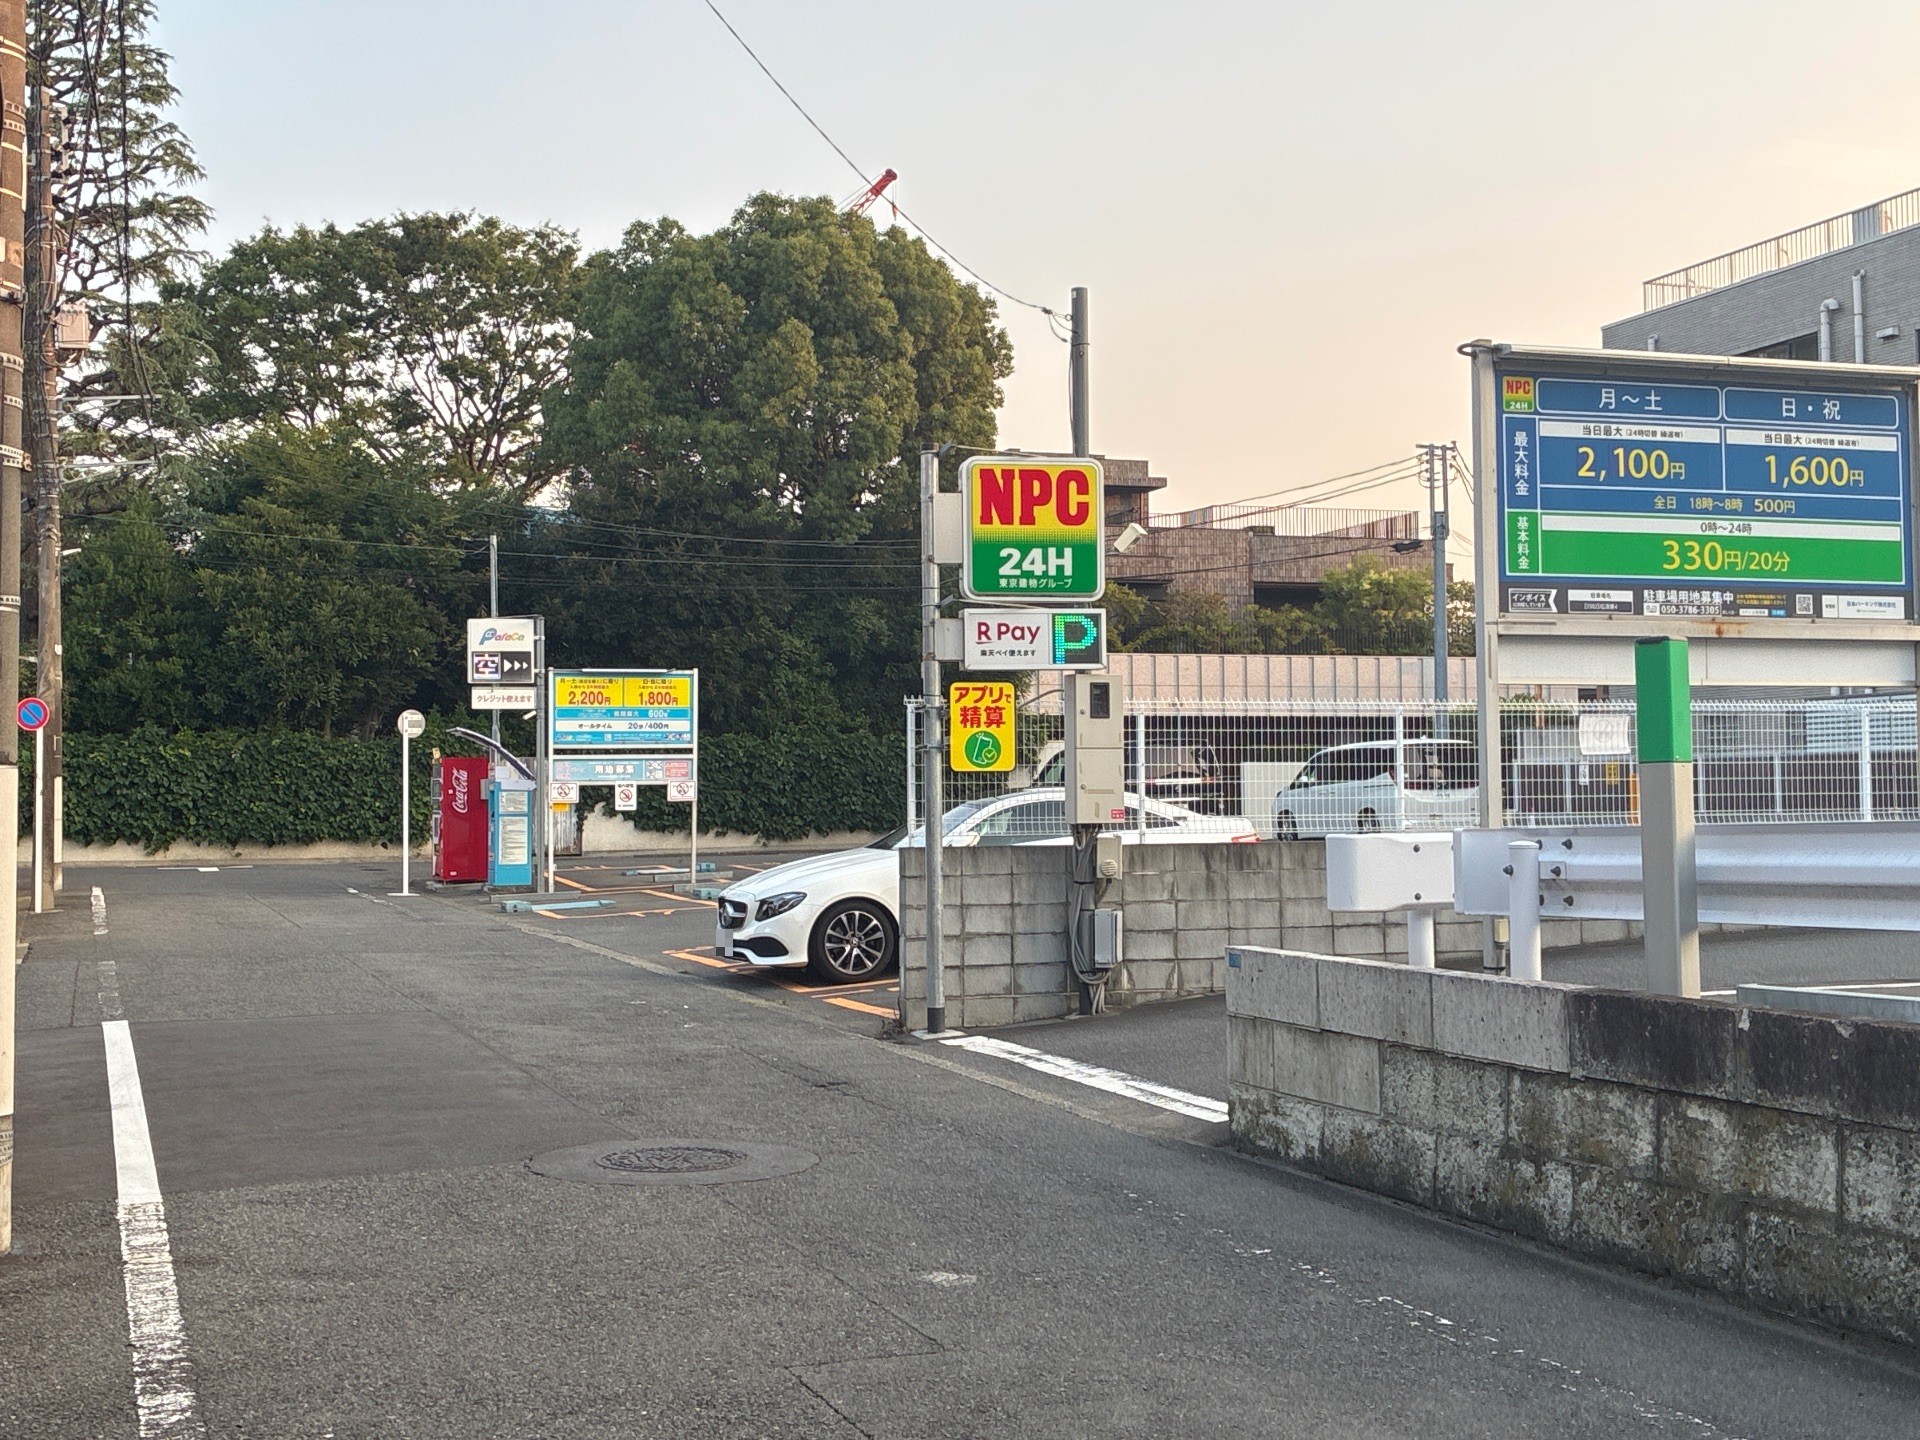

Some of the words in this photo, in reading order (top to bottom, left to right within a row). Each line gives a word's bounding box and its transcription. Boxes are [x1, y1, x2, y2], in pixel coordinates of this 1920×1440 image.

[1505, 380, 1531, 395] NPC
[1509, 401, 1528, 410] 24H
[1599, 389, 1662, 411] 月～土
[1782, 398, 1841, 420] 日・祝
[1582, 424, 1623, 437] 当日最大
[1763, 433, 1803, 445] 当日最大
[1513, 431, 1530, 496] 最大料金
[1577, 446, 1686, 482] 2,100円
[1764, 454, 1864, 489] 1,600円
[979, 468, 1090, 526] NPC
[1653, 495, 1677, 510] 全日
[1754, 498, 1796, 514] 500円
[1700, 522, 1753, 536] 0時～24時
[1517, 515, 1530, 570] 基本料金
[998, 547, 1073, 576] 24H
[1662, 539, 1790, 572] 330円/20分
[998, 577, 1073, 589] 東京建物グループ
[1512, 593, 1546, 602] インボイス
[1643, 589, 1734, 605] 駐車場用地募集中
[976, 621, 993, 643] R
[997, 622, 1041, 645] Pay
[1055, 615, 1097, 664] P
[980, 649, 1037, 657] 楽天ペイ使えます
[474, 653, 499, 678] 空
[476, 694, 532, 703] クレジット使えます
[568, 690, 611, 706] 2,200円
[639, 691, 679, 706] 1,800円
[954, 685, 1012, 704] アプリで
[959, 705, 1006, 728] 精算
